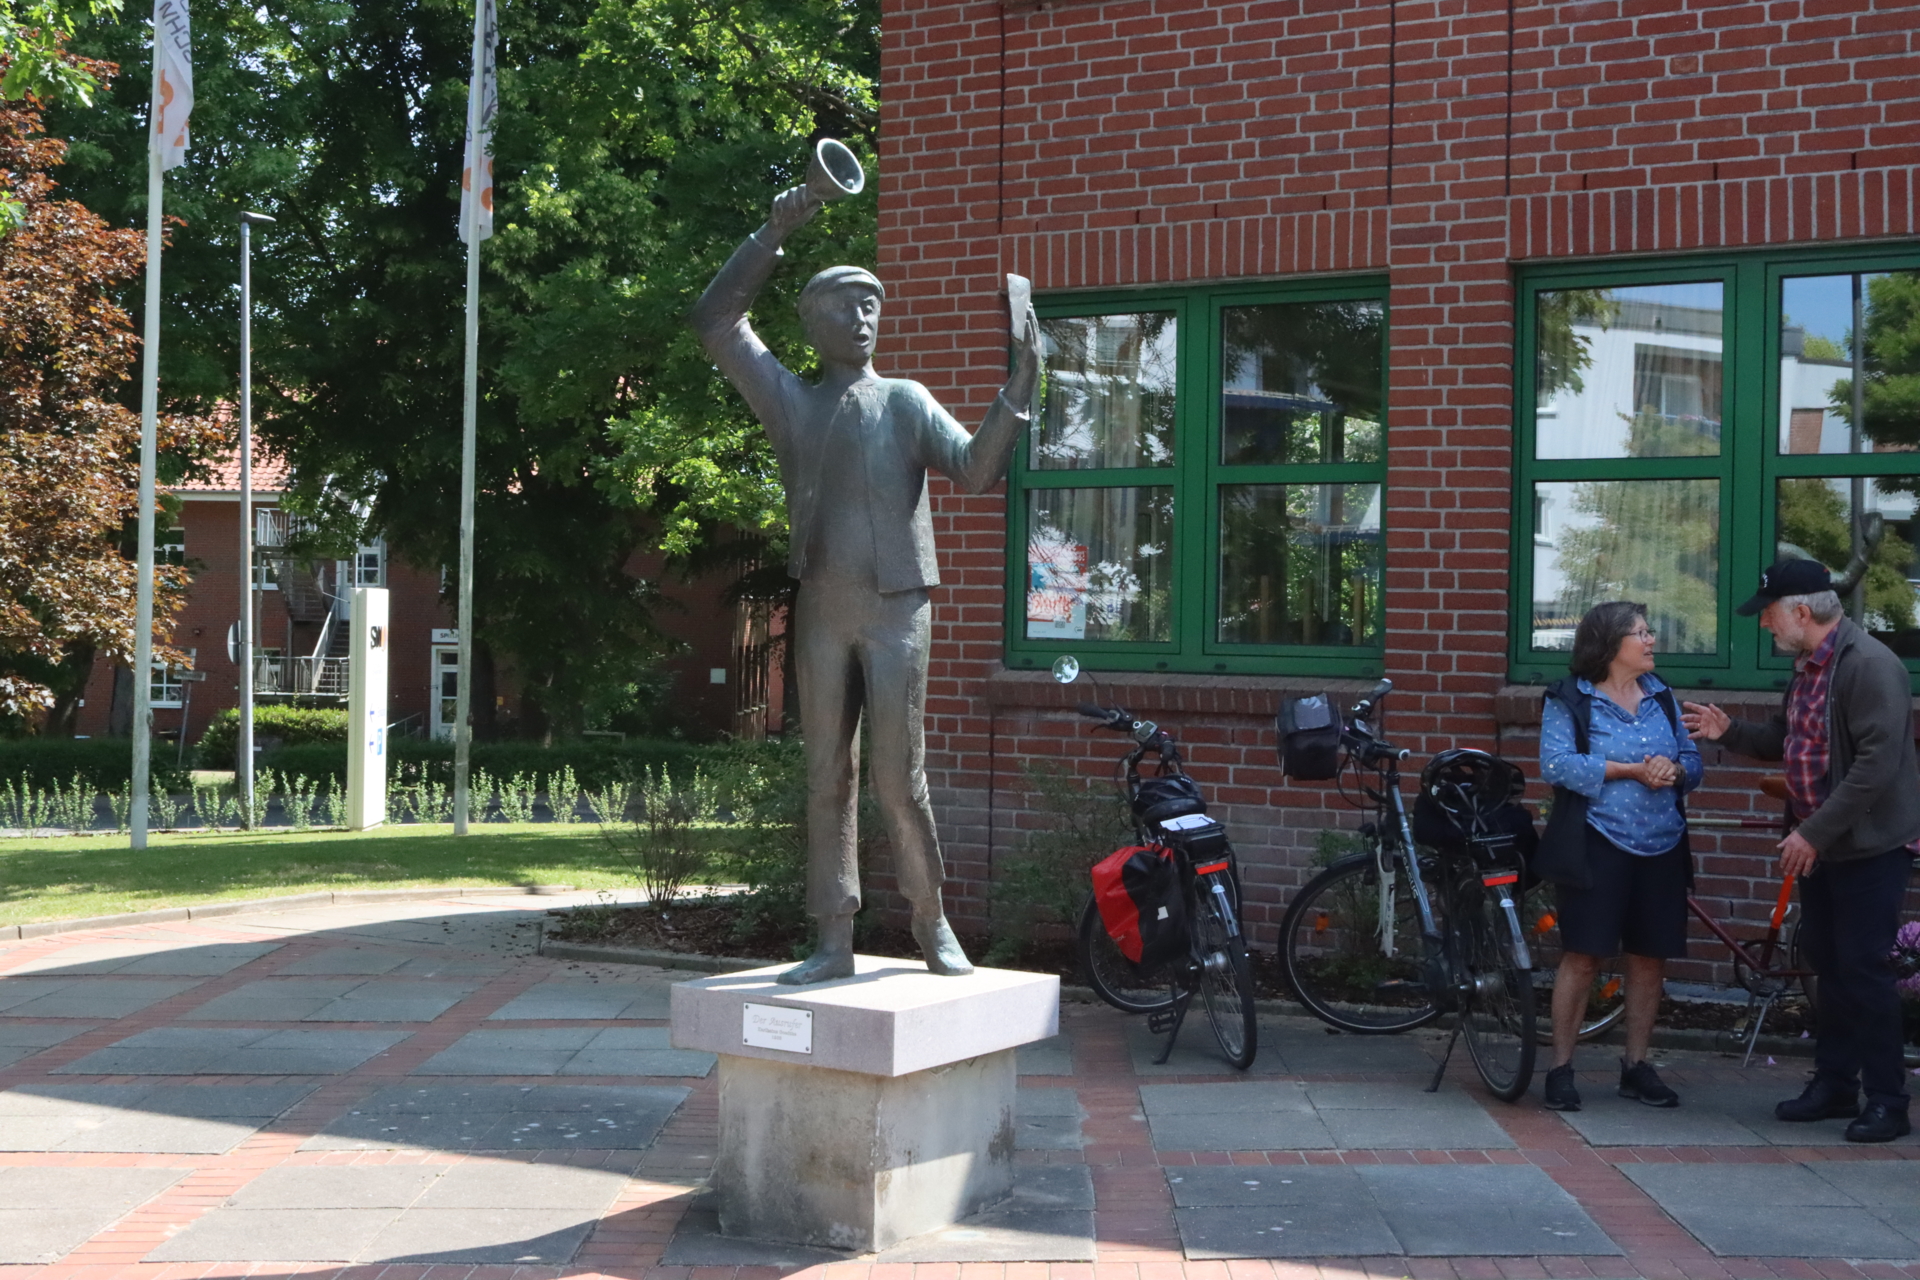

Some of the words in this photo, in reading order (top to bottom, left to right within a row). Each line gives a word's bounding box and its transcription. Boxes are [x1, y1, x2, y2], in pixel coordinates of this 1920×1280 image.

[1398, 840, 1419, 900] PEGASUS
[752, 1014, 767, 1025] Der
[769, 1017, 802, 1031] Ausrufer
